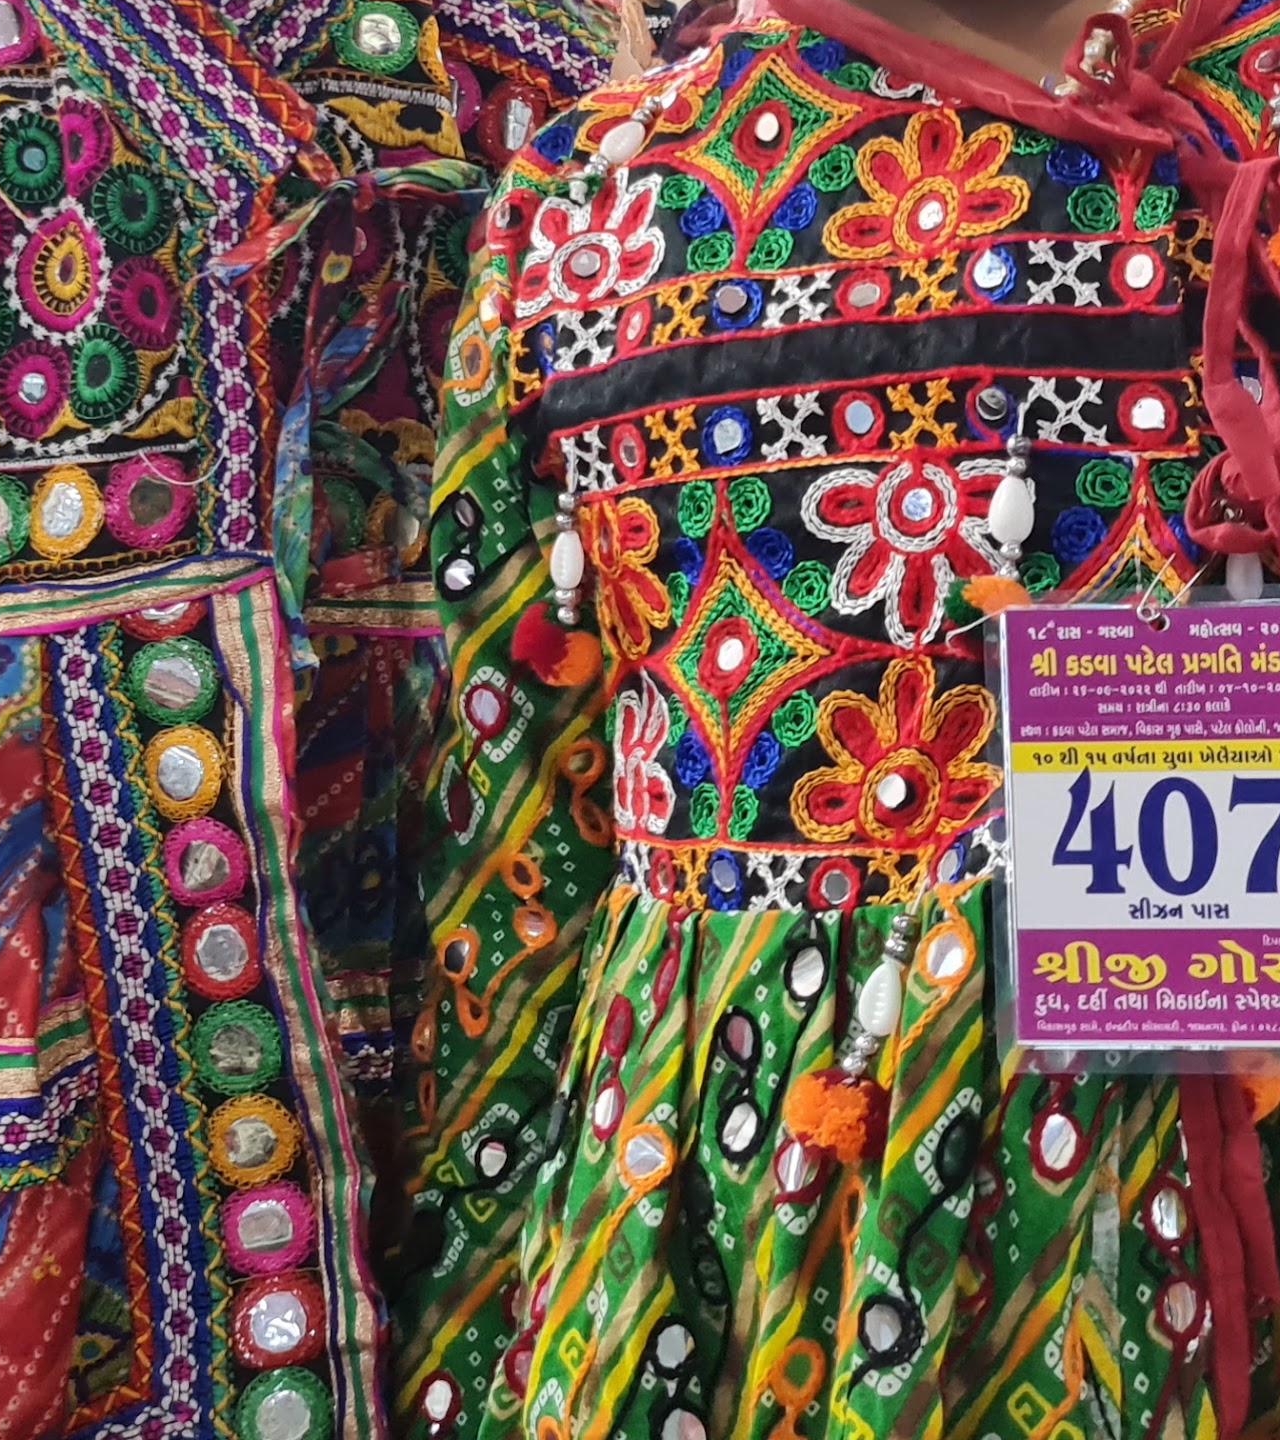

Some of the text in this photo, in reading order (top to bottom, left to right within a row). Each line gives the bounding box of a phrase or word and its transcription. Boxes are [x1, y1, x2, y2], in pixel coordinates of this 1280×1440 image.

[1097, 624, 1134, 640] ગરબા
[1188, 621, 1243, 638] મહોત્સવ
[1029, 644, 1058, 677] શ્રી
[1065, 651, 1117, 677] કડવા
[1124, 644, 1174, 676] પટેલ
[1182, 643, 1243, 676] પ્રગતિ
[1031, 752, 1054, 768] ૧૦
[1058, 746, 1080, 766] થી
[1085, 750, 1108, 766] ૧૫
[1111, 745, 1158, 766] વર્ષના
[1162, 748, 1194, 771] યુવા
[1128, 896, 1231, 921] સીઝન પાસ
[1031, 938, 1168, 992] શ્રીજી
[1113, 991, 1149, 1012] તથા
[1155, 987, 1229, 1012] મિઠાઈના
